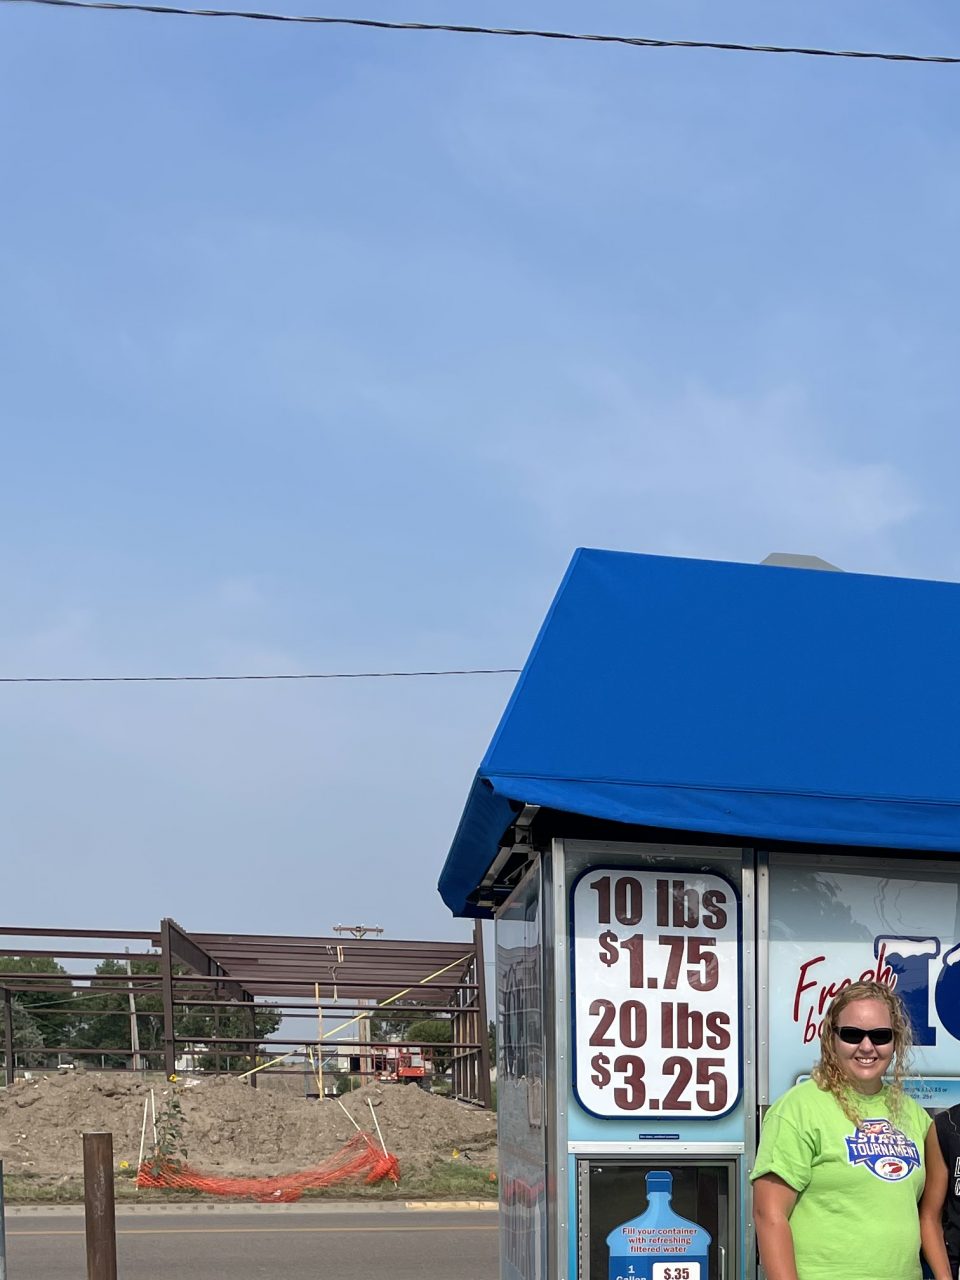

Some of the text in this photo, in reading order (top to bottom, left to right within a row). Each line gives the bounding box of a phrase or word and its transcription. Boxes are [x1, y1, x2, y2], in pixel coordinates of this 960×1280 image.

[590, 876, 728, 930] 10 lbs
[598, 929, 719, 992] $1.75
[588, 998, 731, 1051] 20 lbs
[590, 1051, 728, 1112] $3.25
[858, 1132, 906, 1145] STATE
[849, 1143, 918, 1159] TOURNAMENT
[622, 1227, 697, 1237] Fill your container
[628, 1236, 691, 1245] with refreshing
[627, 1265, 636, 1274] 1
